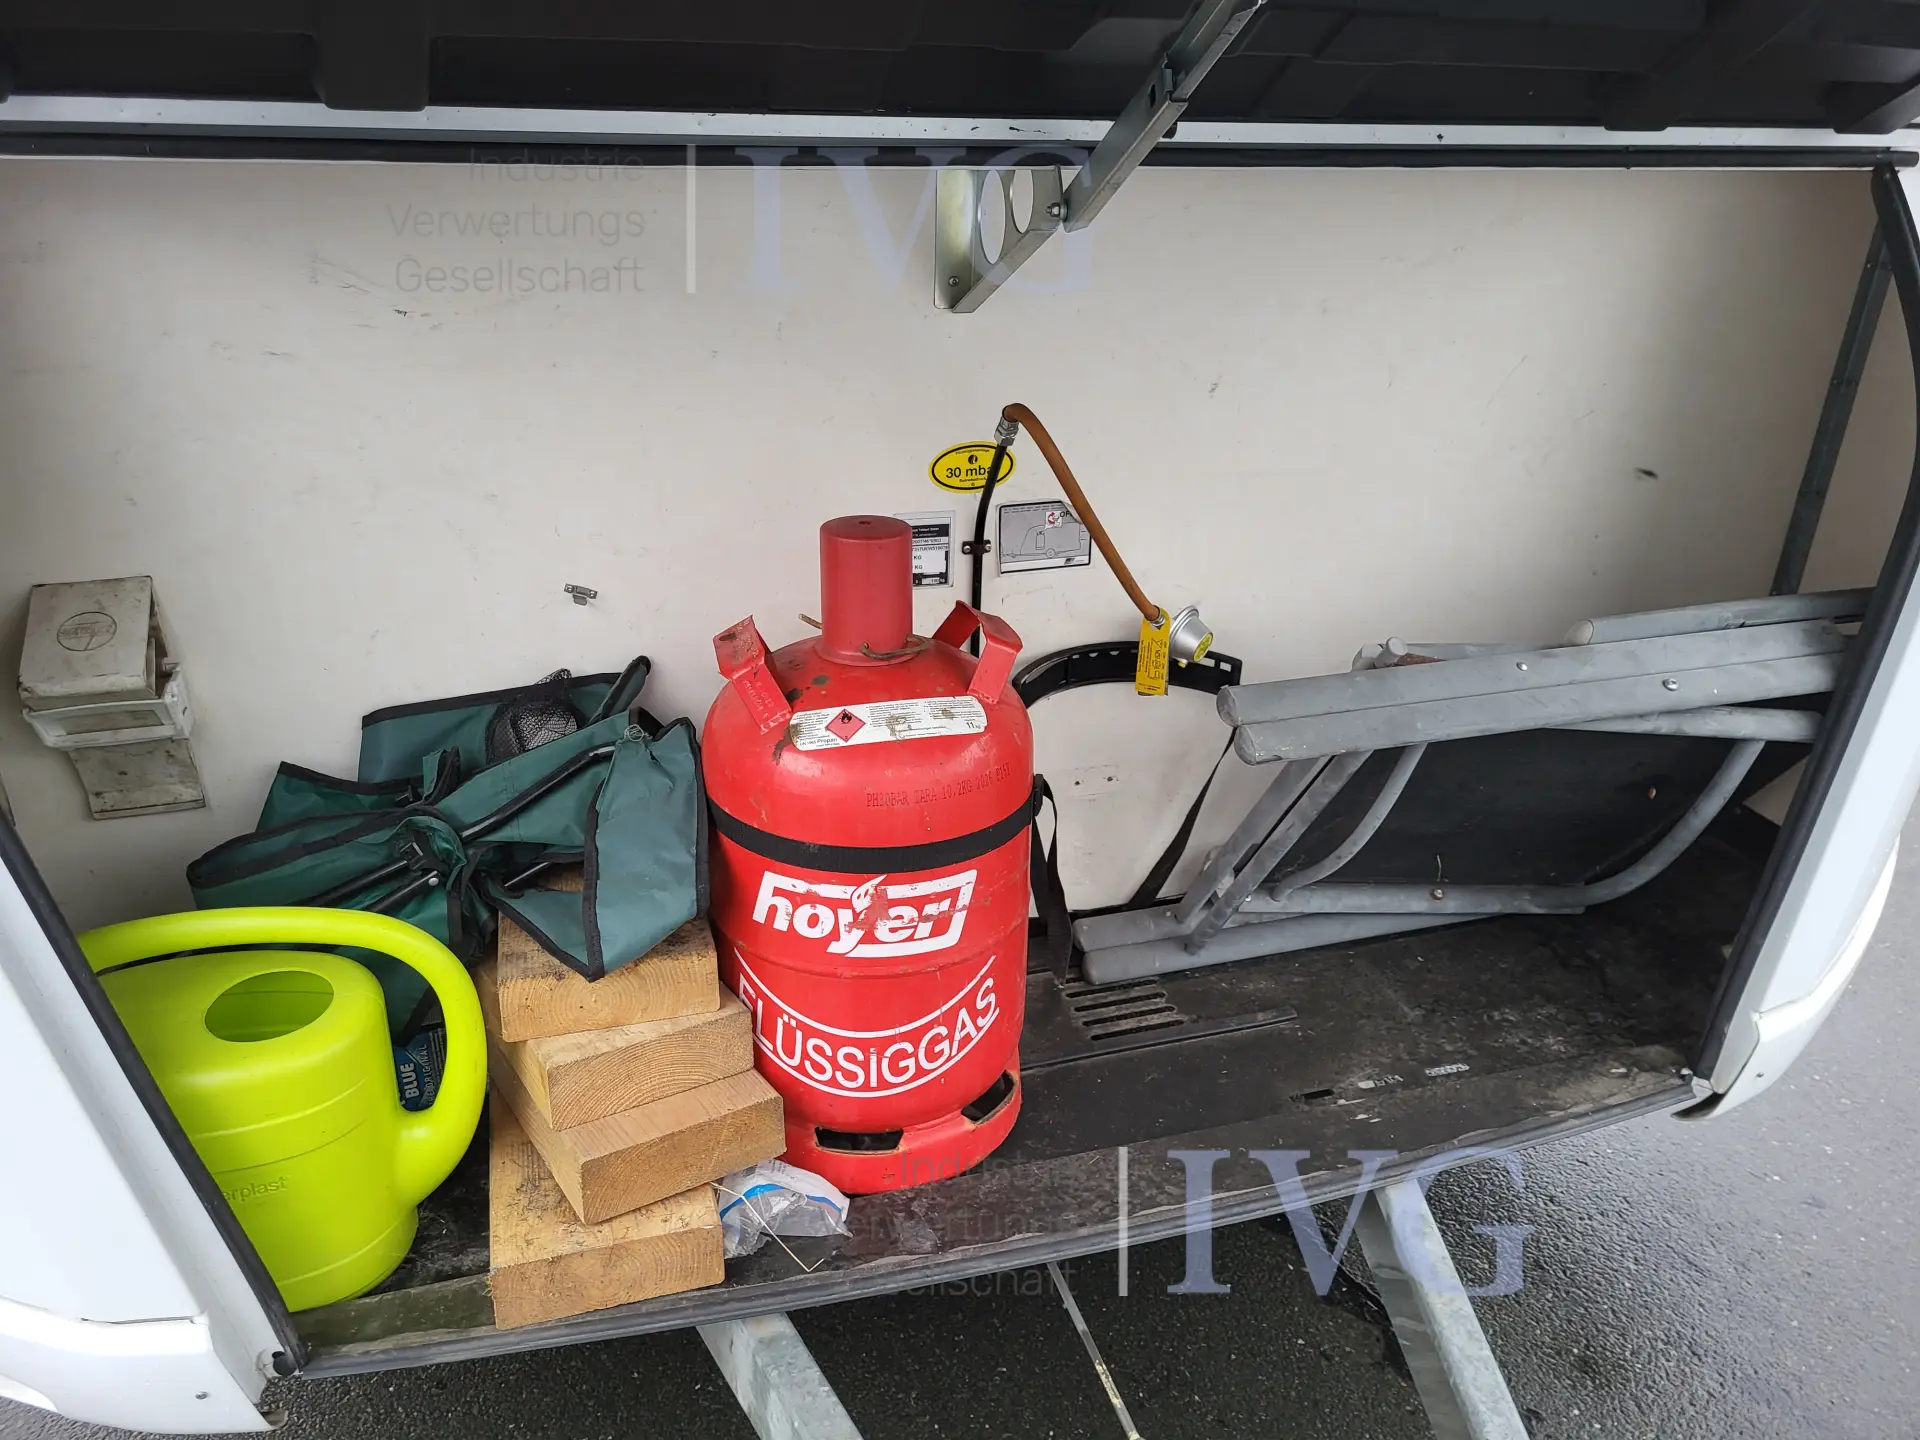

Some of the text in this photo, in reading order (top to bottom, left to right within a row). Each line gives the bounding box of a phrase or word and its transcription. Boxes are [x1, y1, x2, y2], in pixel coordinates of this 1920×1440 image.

[945, 465, 992, 479] 30 mba
[914, 787, 938, 804] TARA
[752, 870, 972, 957] hoyer
[400, 1062, 420, 1099] BLUE
